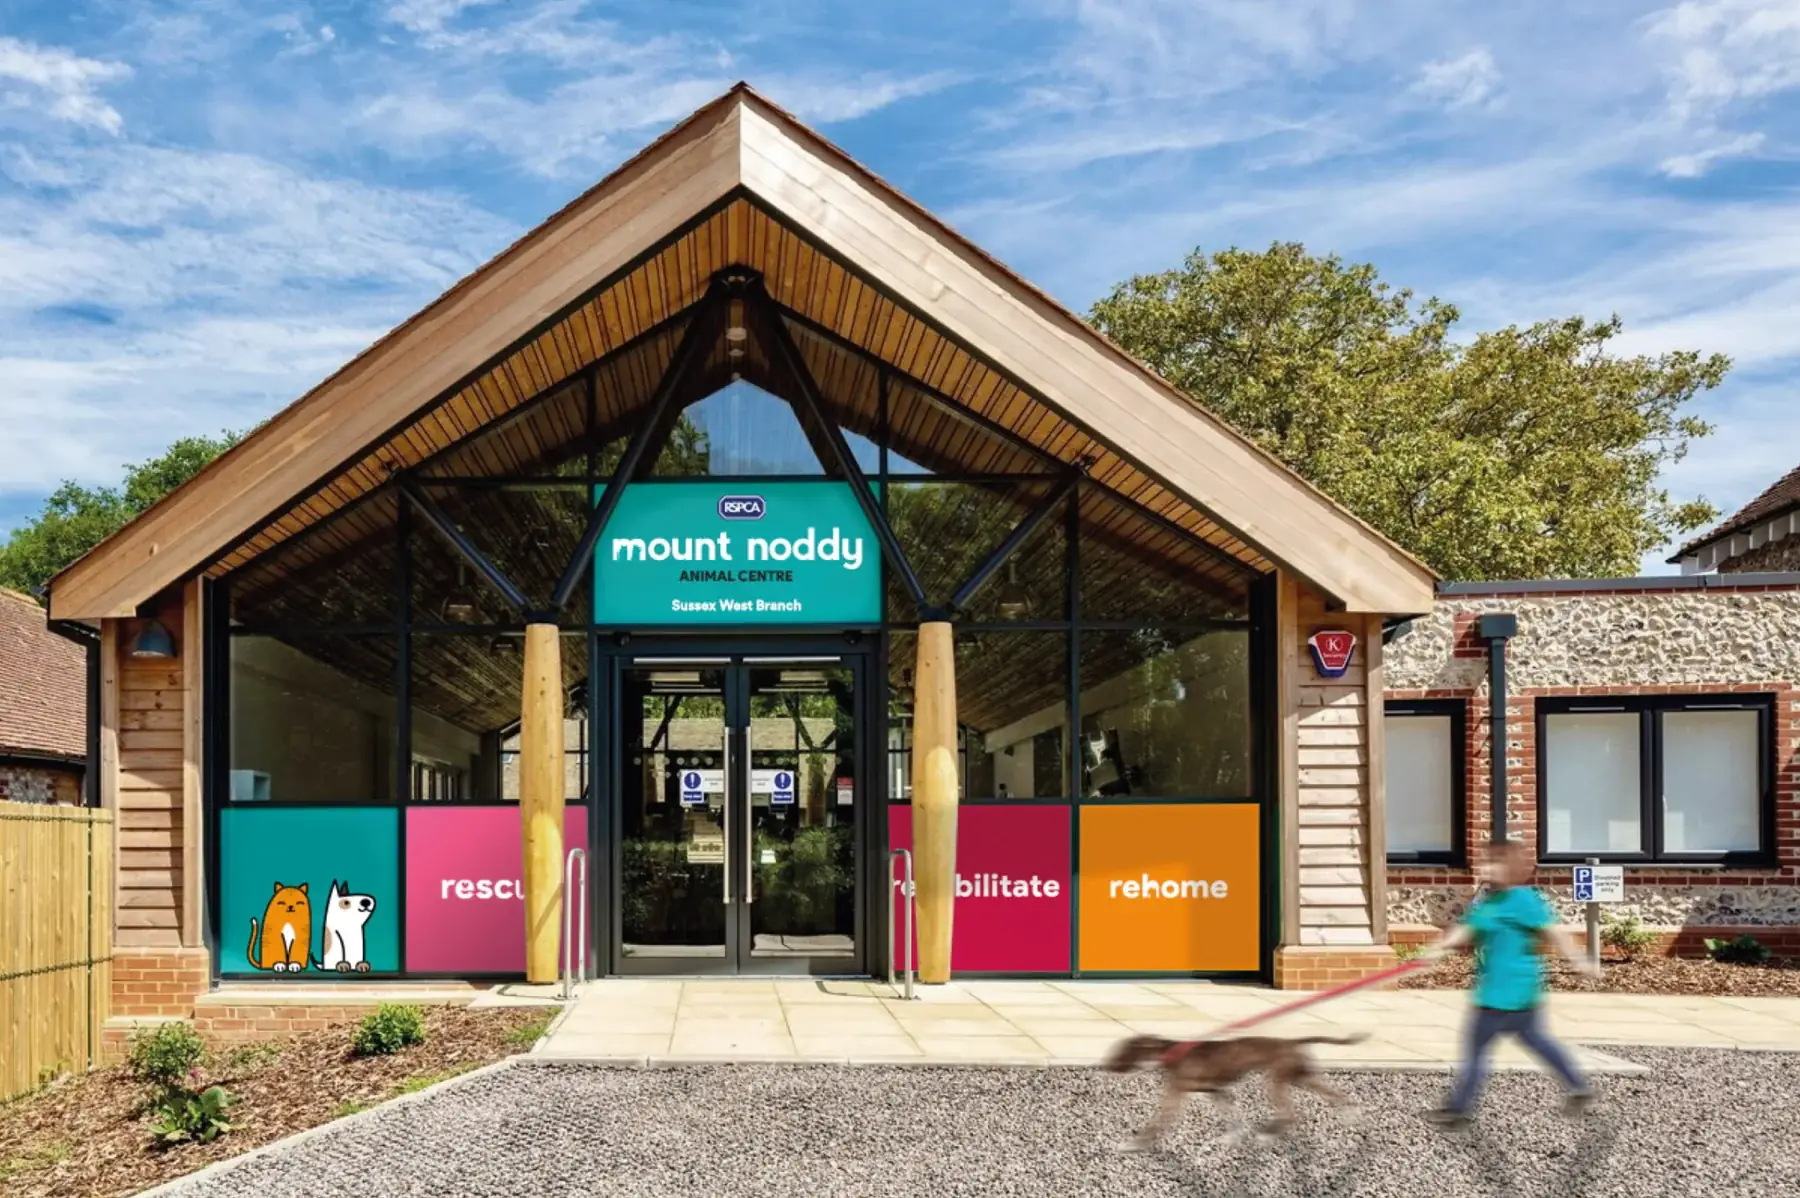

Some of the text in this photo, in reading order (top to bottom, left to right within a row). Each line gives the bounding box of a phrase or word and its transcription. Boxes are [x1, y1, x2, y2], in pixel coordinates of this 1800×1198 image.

[723, 501, 761, 514] RSPCA
[612, 527, 864, 570] mount noddy
[679, 570, 794, 583] ANIMAL CENTRE
[671, 599, 803, 612] Sussex West Branch
[1327, 636, 1342, 652] K
[1579, 869, 1590, 882] P
[441, 879, 525, 900] resc
[891, 873, 1061, 898] ebilitate
[1109, 872, 1229, 899] rehome
